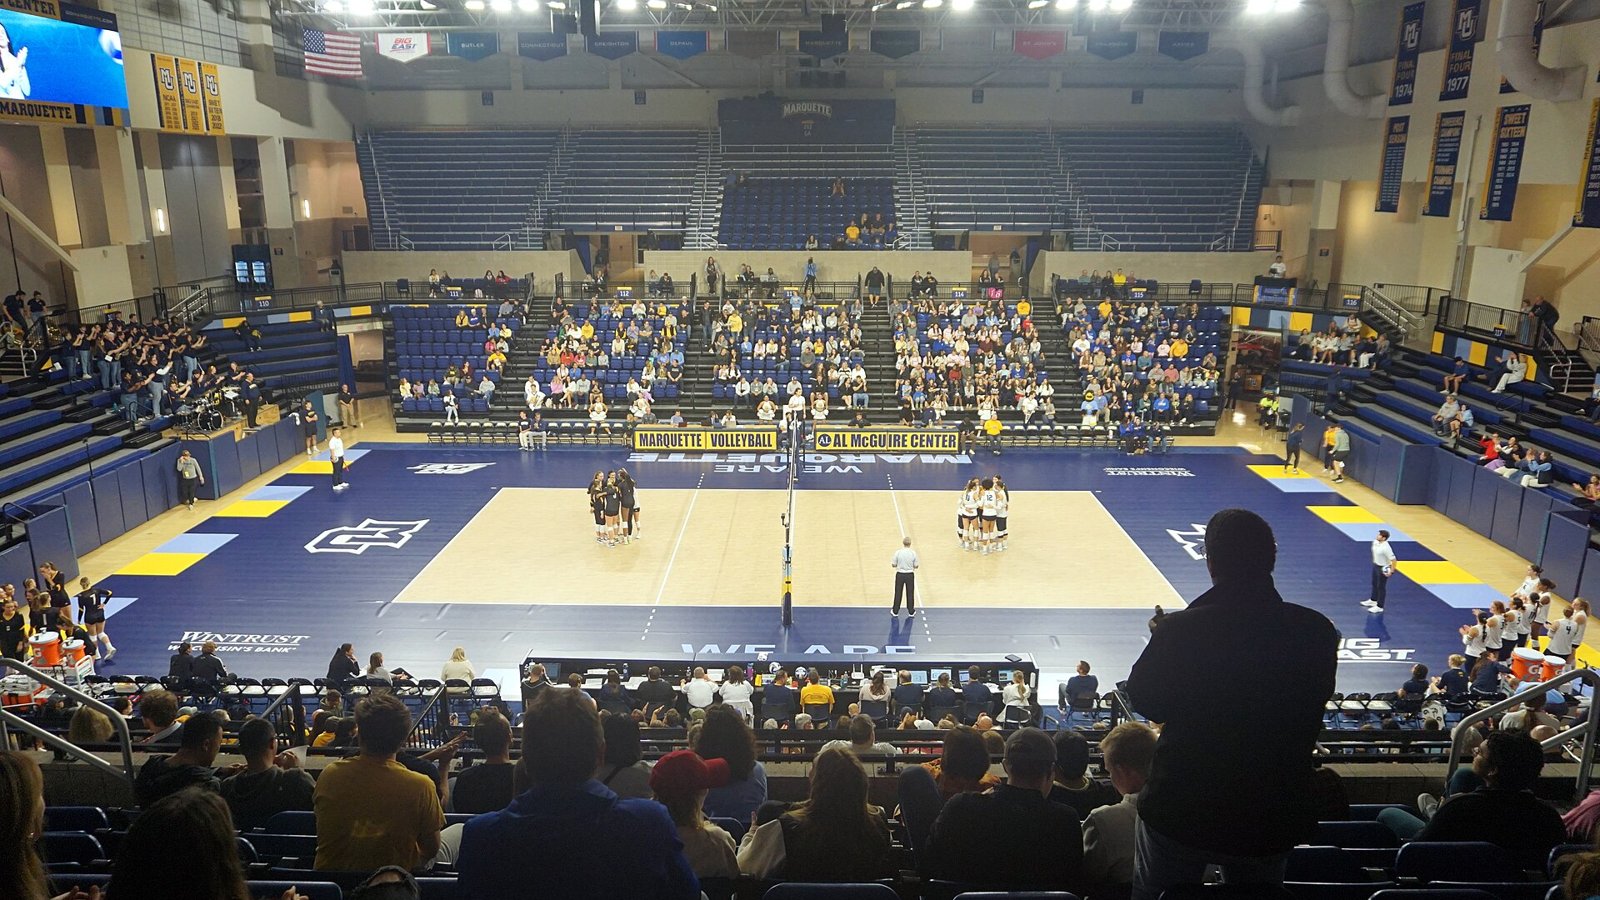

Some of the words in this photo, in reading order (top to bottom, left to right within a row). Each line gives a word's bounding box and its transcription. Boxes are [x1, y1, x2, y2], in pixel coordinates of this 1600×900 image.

[1449, 61, 1471, 73] FOUR
[1395, 84, 1413, 97] 1974
[1447, 76, 1469, 92] 1977
[0, 101, 72, 119] MARQUETTE
[783, 102, 832, 118] MARQUETTE
[639, 433, 702, 448] MARQUETTE
[711, 433, 772, 447] VOLLEYBALL
[833, 434, 848, 448] AL
[851, 433, 908, 448] McGUIRE
[910, 434, 957, 448] CENTER
[181, 631, 311, 644] WINTRUST
[1338, 637, 1380, 649] IG
[1336, 649, 1416, 660] AST
